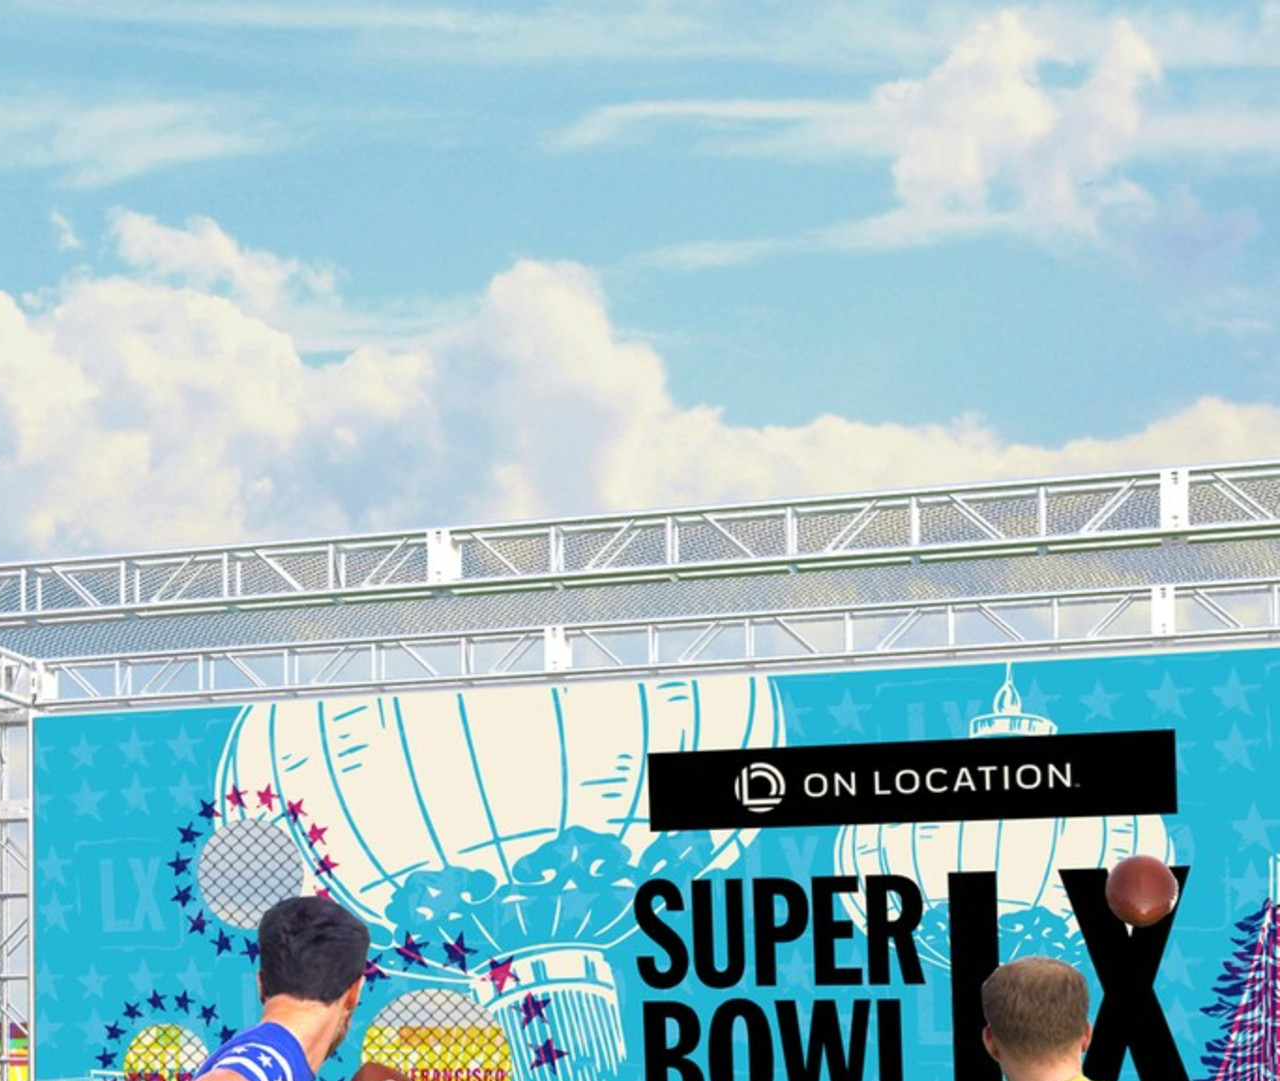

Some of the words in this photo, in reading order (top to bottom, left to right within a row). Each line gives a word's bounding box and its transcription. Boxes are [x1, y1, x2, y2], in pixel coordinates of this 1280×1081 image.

[803, 770, 857, 798] ON
[873, 762, 1072, 796] LOCATION
[633, 873, 926, 990] SUPER
